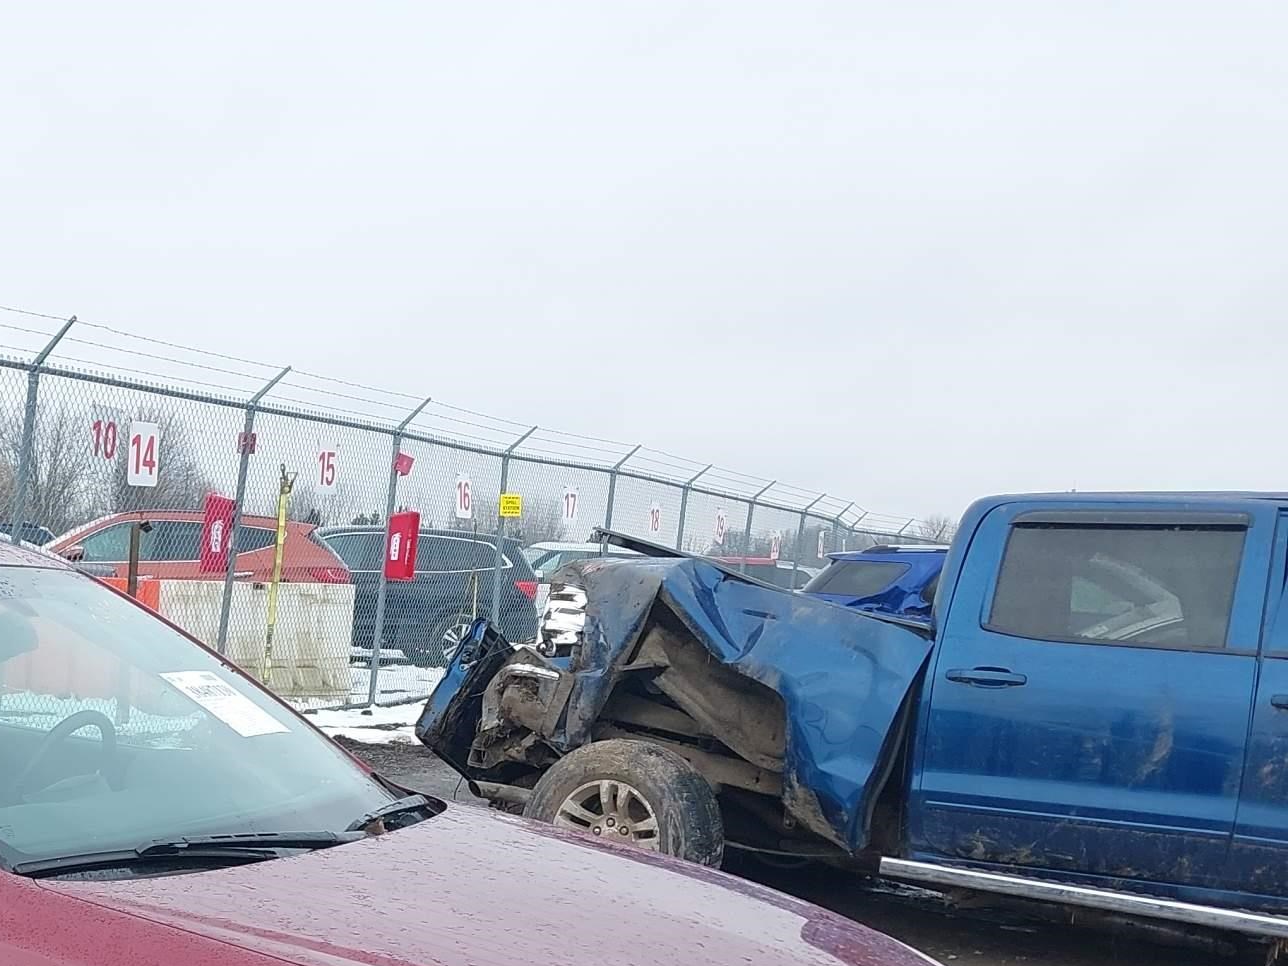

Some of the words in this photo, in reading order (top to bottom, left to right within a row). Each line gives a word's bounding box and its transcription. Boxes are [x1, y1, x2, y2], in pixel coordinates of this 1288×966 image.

[93, 419, 117, 459] 10
[132, 433, 156, 475] 14
[319, 451, 336, 486] 15
[457, 481, 470, 511] 16
[564, 492, 577, 518] 17
[651, 508, 660, 532] 18
[716, 514, 725, 538] 19
